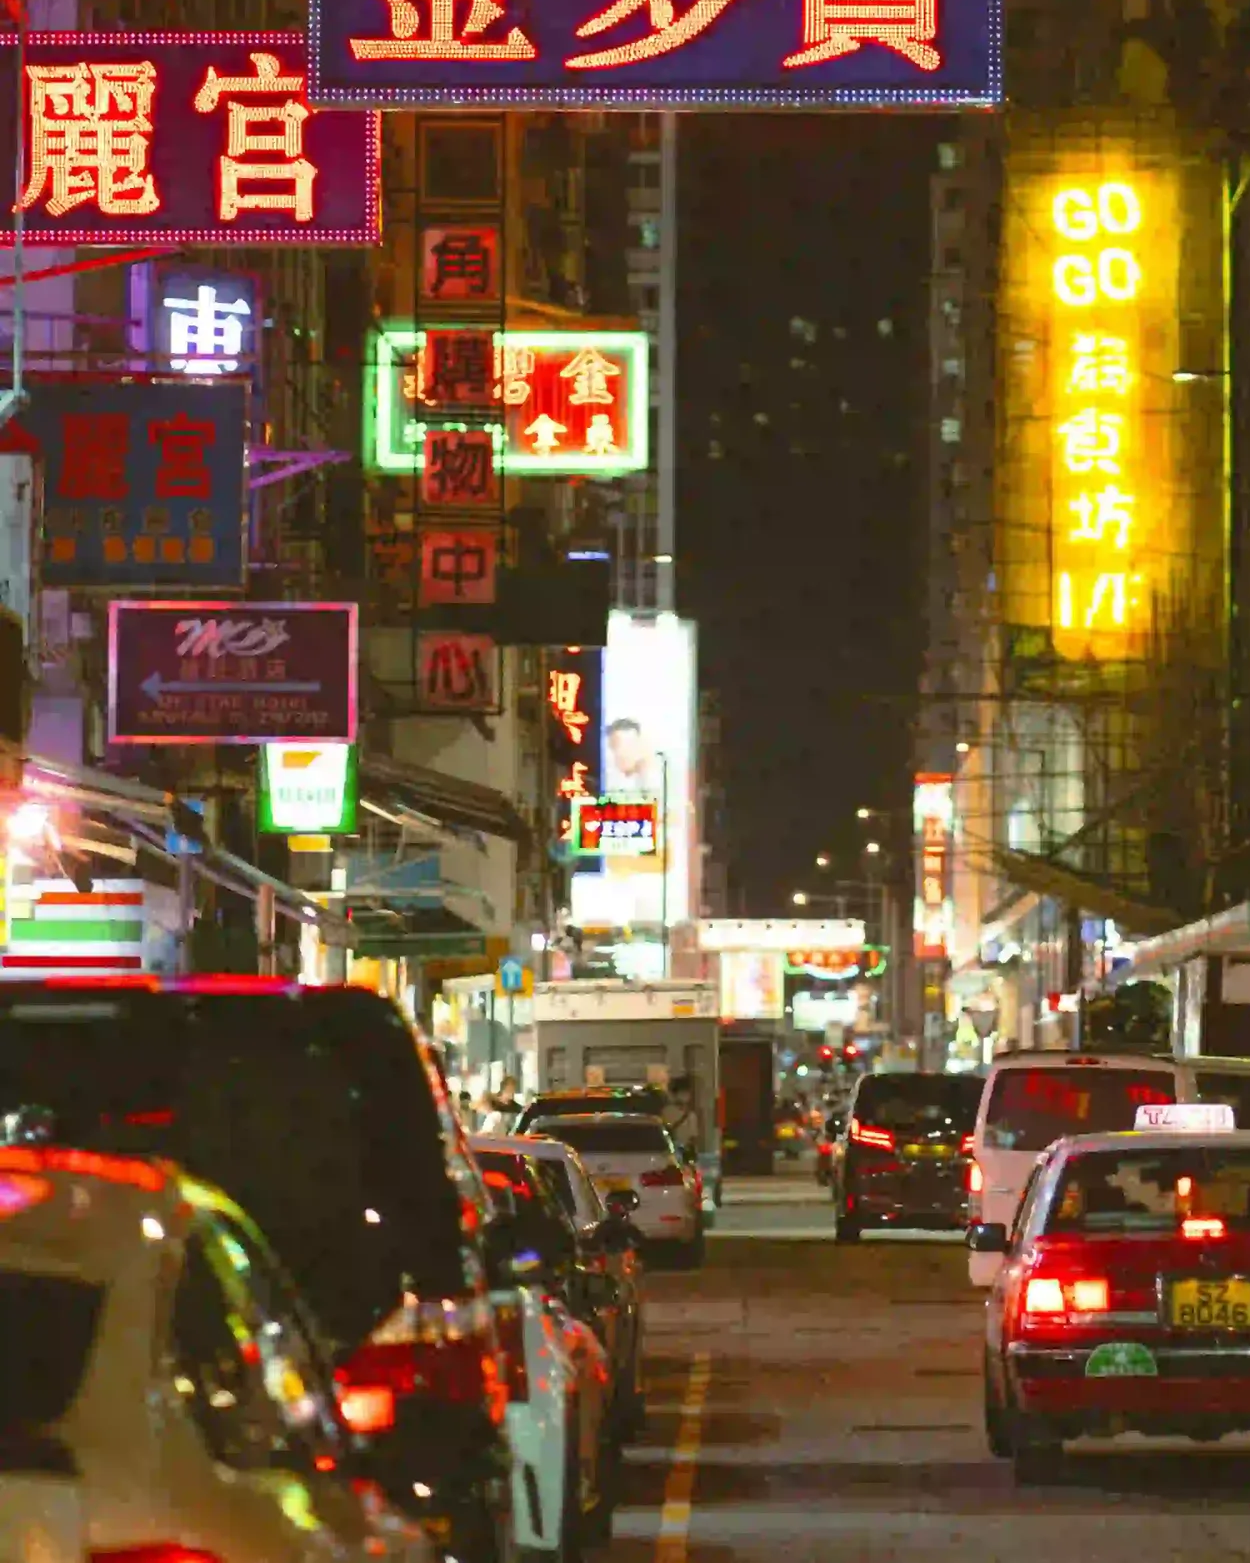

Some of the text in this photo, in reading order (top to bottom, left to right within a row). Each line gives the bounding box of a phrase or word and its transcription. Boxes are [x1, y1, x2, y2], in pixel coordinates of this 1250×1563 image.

[12, 51, 319, 222] 麗宮
[1052, 182, 1142, 241] GO
[1052, 247, 1142, 306] GO
